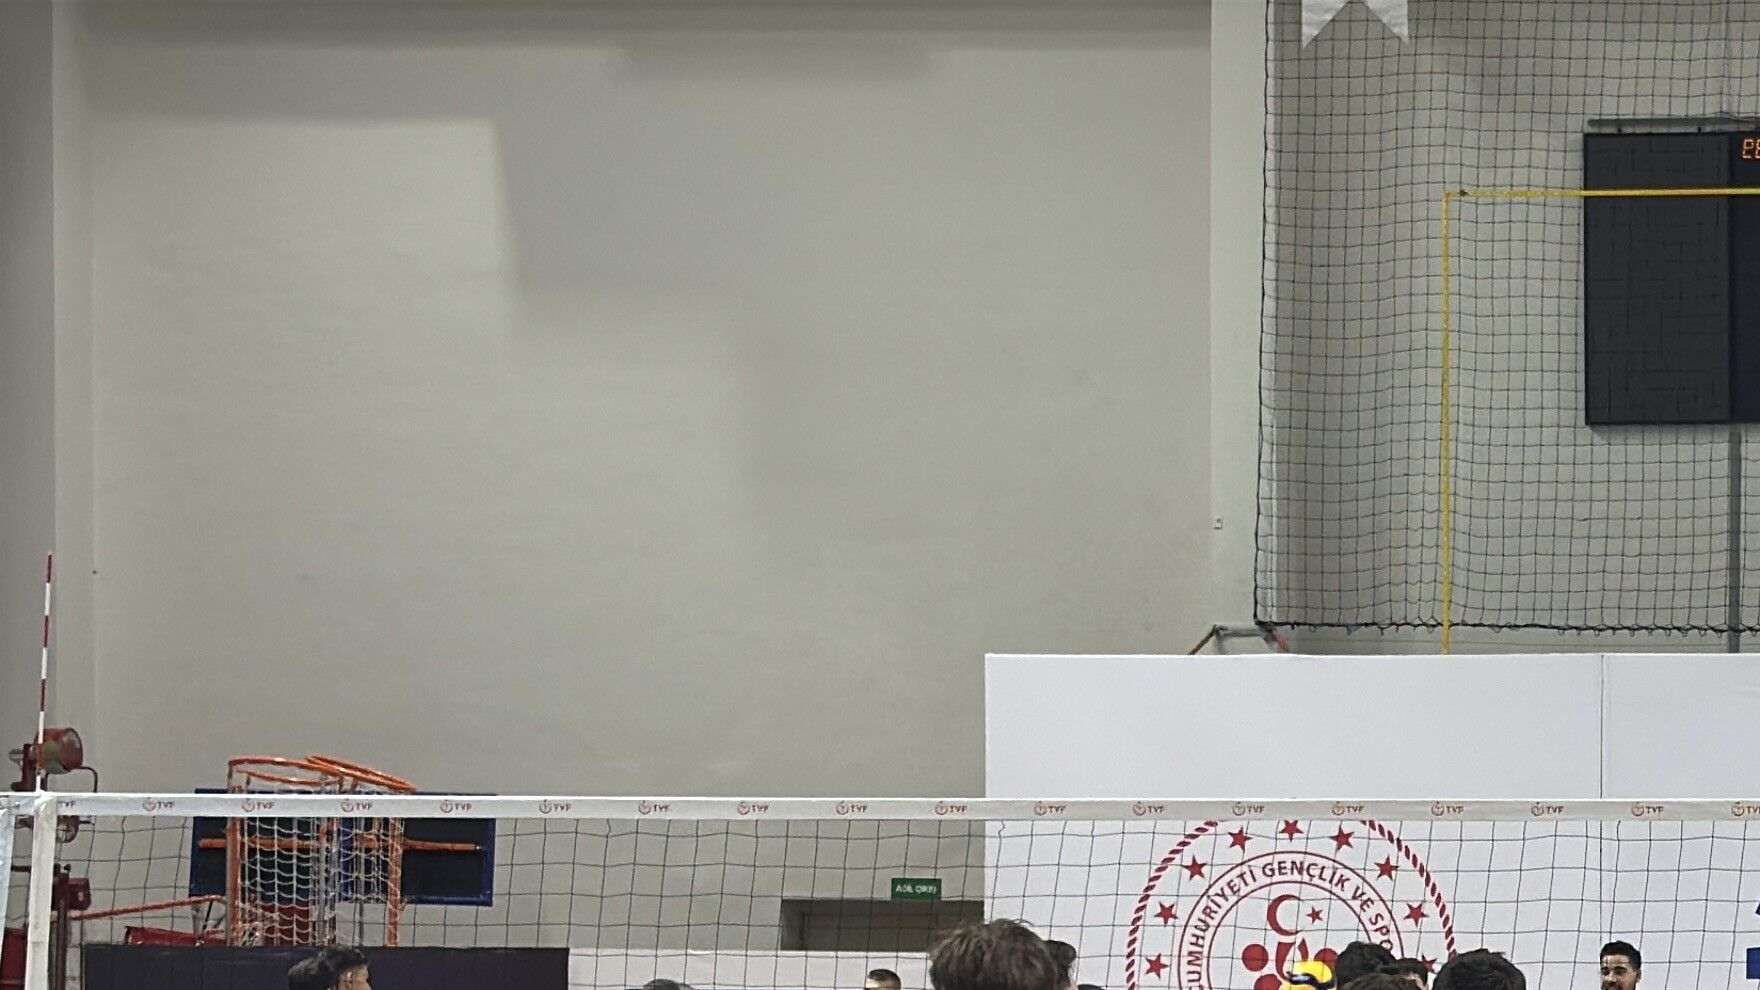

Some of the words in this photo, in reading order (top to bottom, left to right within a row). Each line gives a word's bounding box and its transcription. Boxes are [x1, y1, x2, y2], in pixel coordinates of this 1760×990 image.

[1262, 859, 1347, 892] GENÇLİK
[1350, 886, 1373, 913] VE
[1368, 913, 1394, 951] SPO
